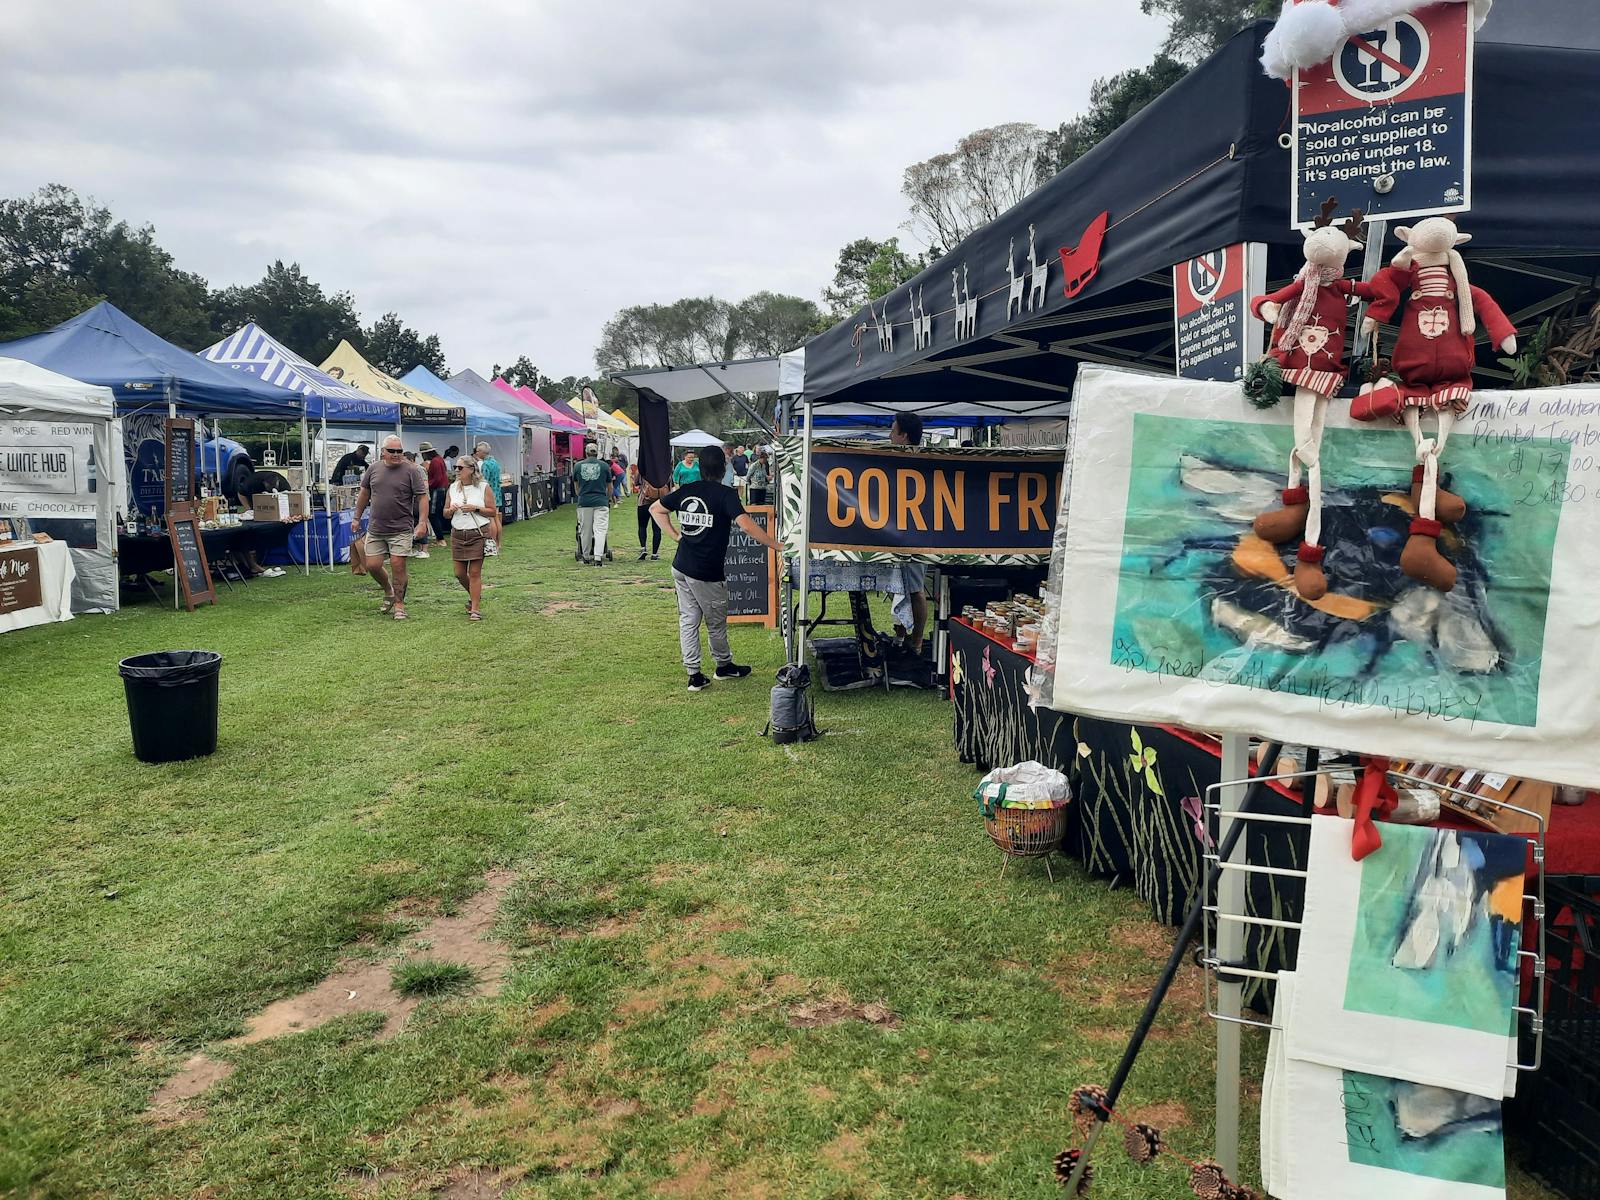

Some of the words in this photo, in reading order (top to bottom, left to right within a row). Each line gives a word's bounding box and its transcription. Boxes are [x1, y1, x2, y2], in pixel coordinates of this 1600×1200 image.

[1306, 122, 1327, 135] No
[1331, 113, 1387, 132] alcohol
[1391, 111, 1419, 124] can
[1424, 107, 1444, 119] be
[1306, 135, 1337, 151] sold
[1342, 135, 1358, 146] or
[1362, 124, 1427, 144] supplied
[1431, 123, 1448, 134] to
[1306, 151, 1360, 167] anyone
[1365, 144, 1409, 159] under
[1414, 139, 1436, 152] 18.
[1306, 170, 1327, 182] It's
[1331, 162, 1387, 180] against
[1391, 159, 1416, 171] the
[1420, 156, 1450, 168] law.
[1212, 306, 1224, 318] can
[1225, 302, 1235, 312] be
[1180, 331, 1193, 344] sold
[1193, 330, 1200, 338] or
[1201, 316, 1228, 335] supplied
[1229, 314, 1236, 323] to
[1181, 342, 1201, 356] anyone
[1202, 334, 1220, 347] under
[1190, 349, 1212, 365] against
[1213, 346, 1223, 356] the
[1224, 341, 1237, 351] law.
[52, 427, 70, 435] RED
[73, 427, 94, 435] WIN
[42, 453, 67, 472] HUB
[28, 503, 86, 512] CHOCOLATE
[825, 467, 966, 531] CORN
[988, 471, 1062, 531] FR
[1146, 646, 1204, 684] Great
